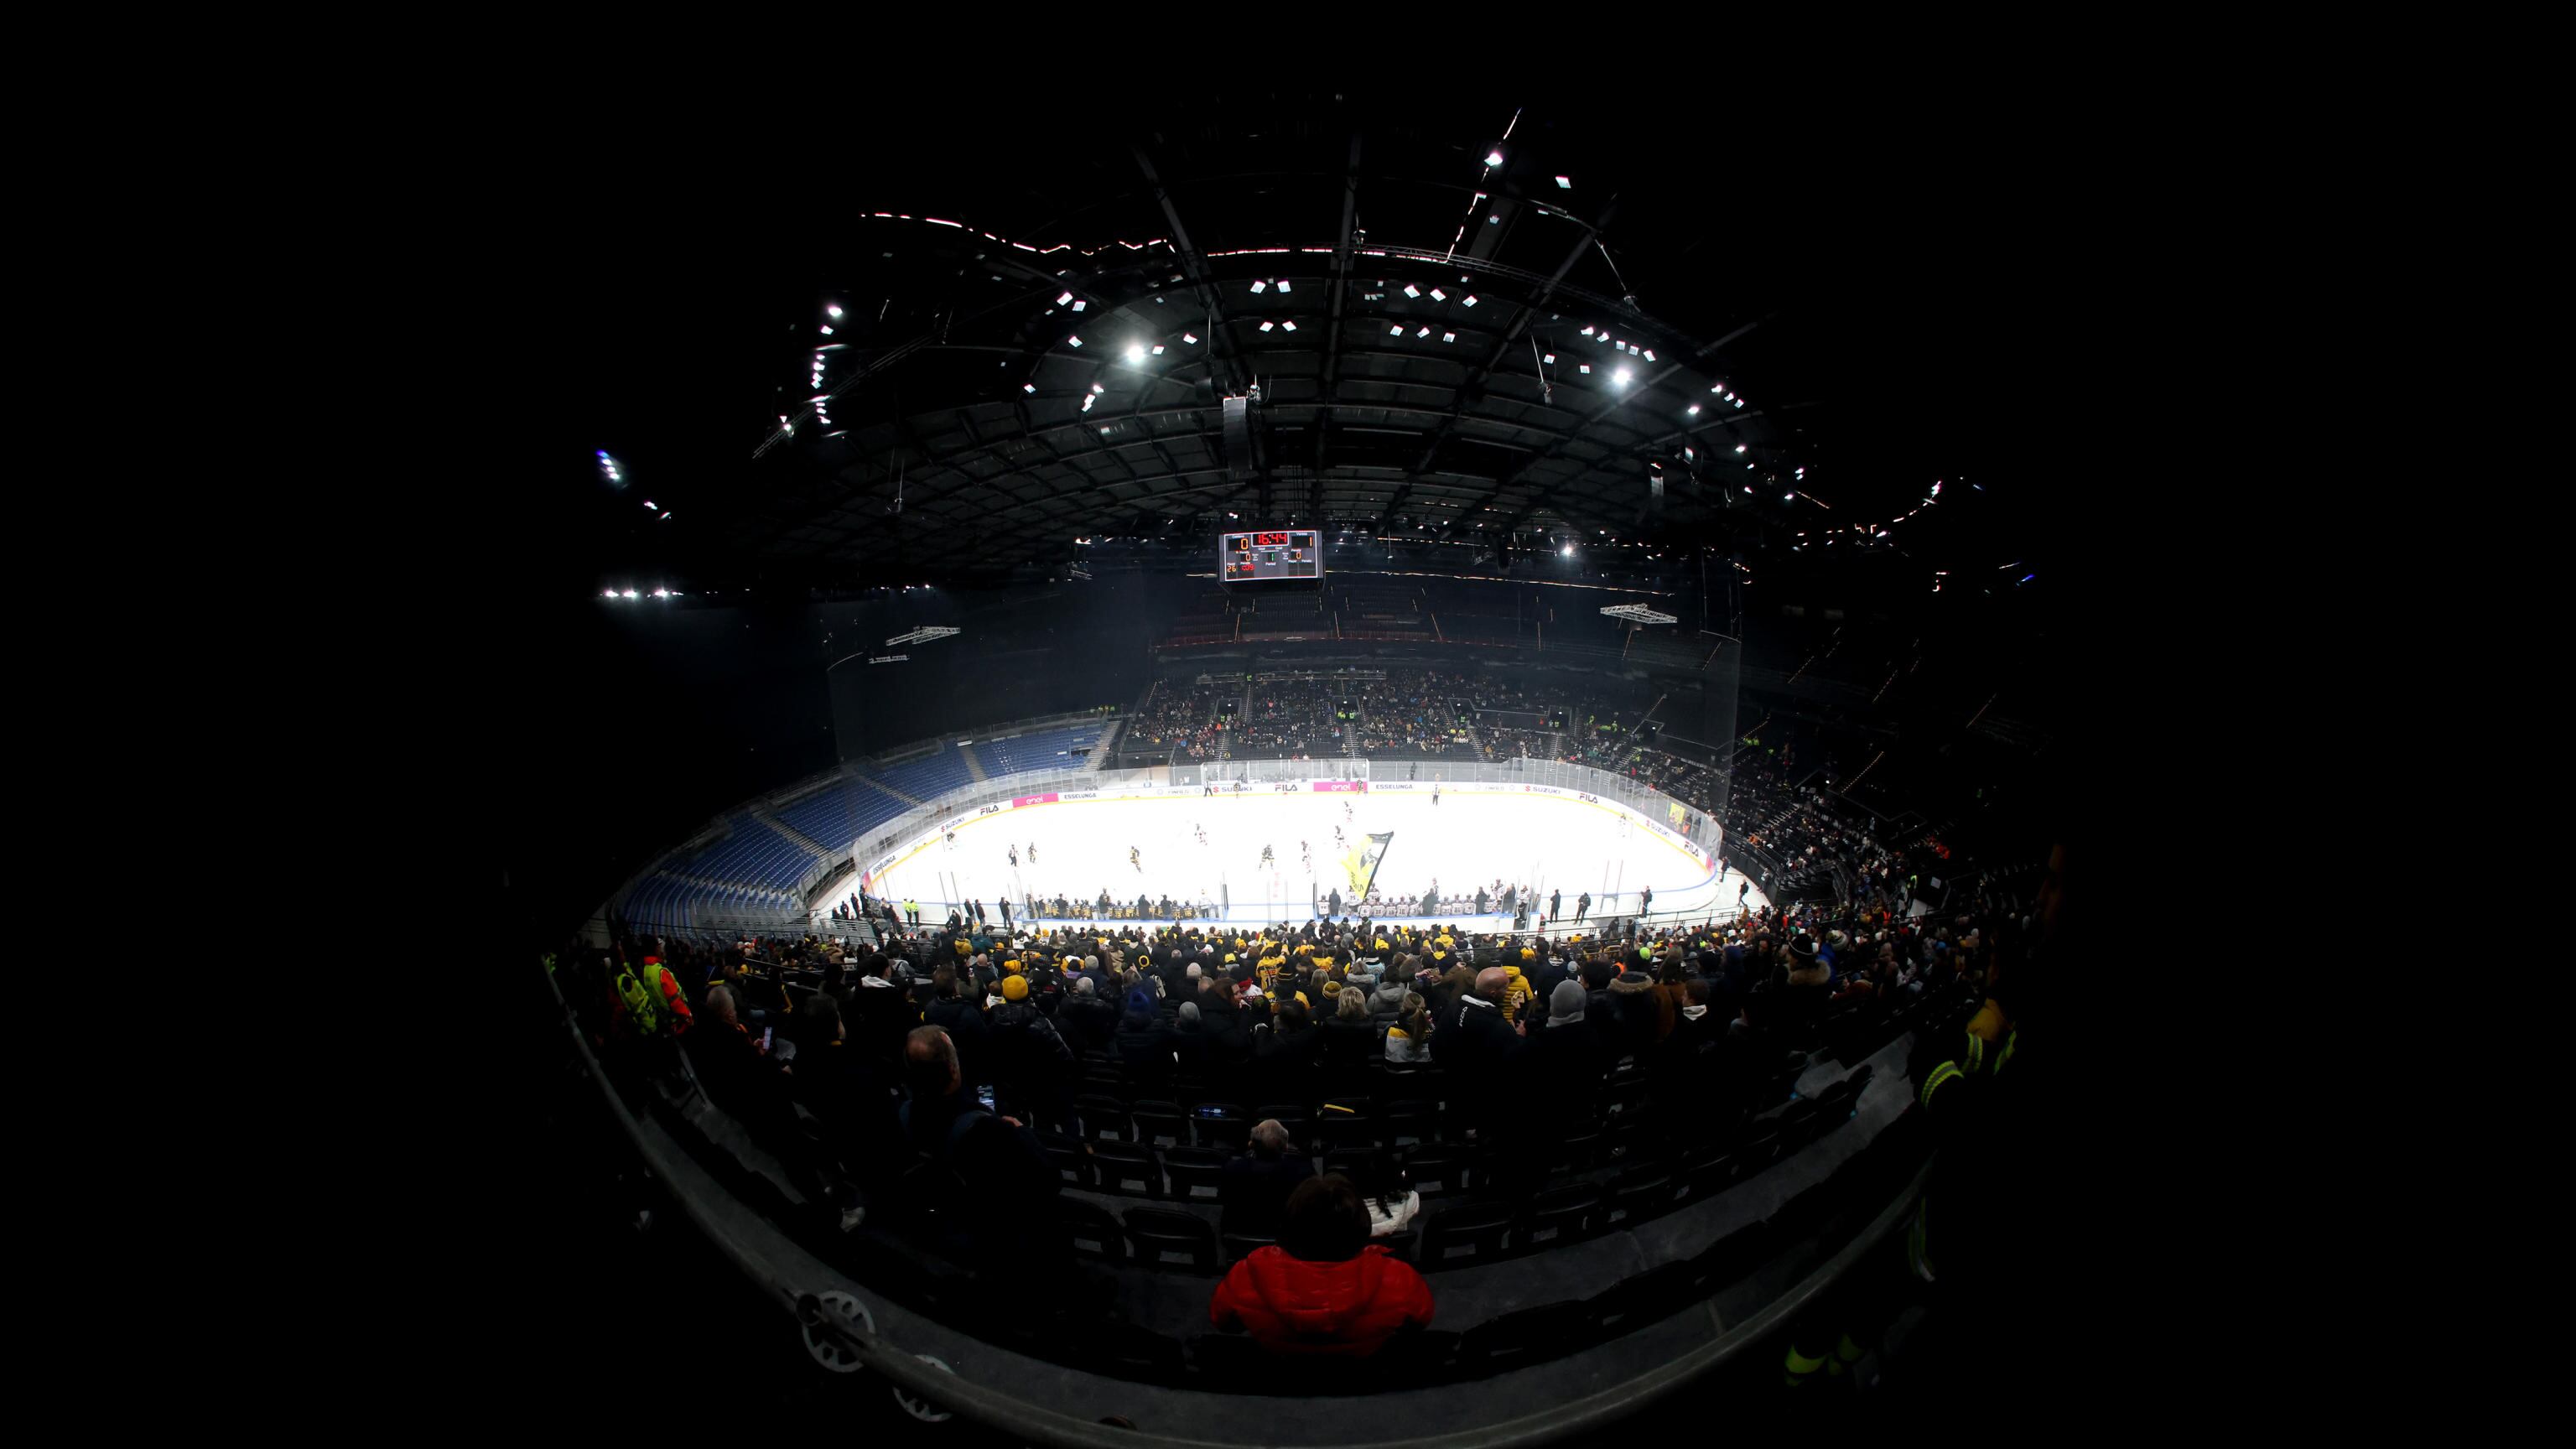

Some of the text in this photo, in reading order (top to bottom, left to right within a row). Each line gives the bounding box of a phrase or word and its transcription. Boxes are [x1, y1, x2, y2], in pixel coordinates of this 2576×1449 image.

[1241, 538, 1249, 550] 0
[1258, 533, 1287, 544] 16:44
[1533, 787, 1561, 795] SUZUKI
[1026, 796, 1043, 805] enel
[1580, 793, 1598, 803] FILA
[980, 804, 1000, 816] FILA
[946, 818, 964, 829] SUZUKI
[1684, 840, 1699, 857] FILA
